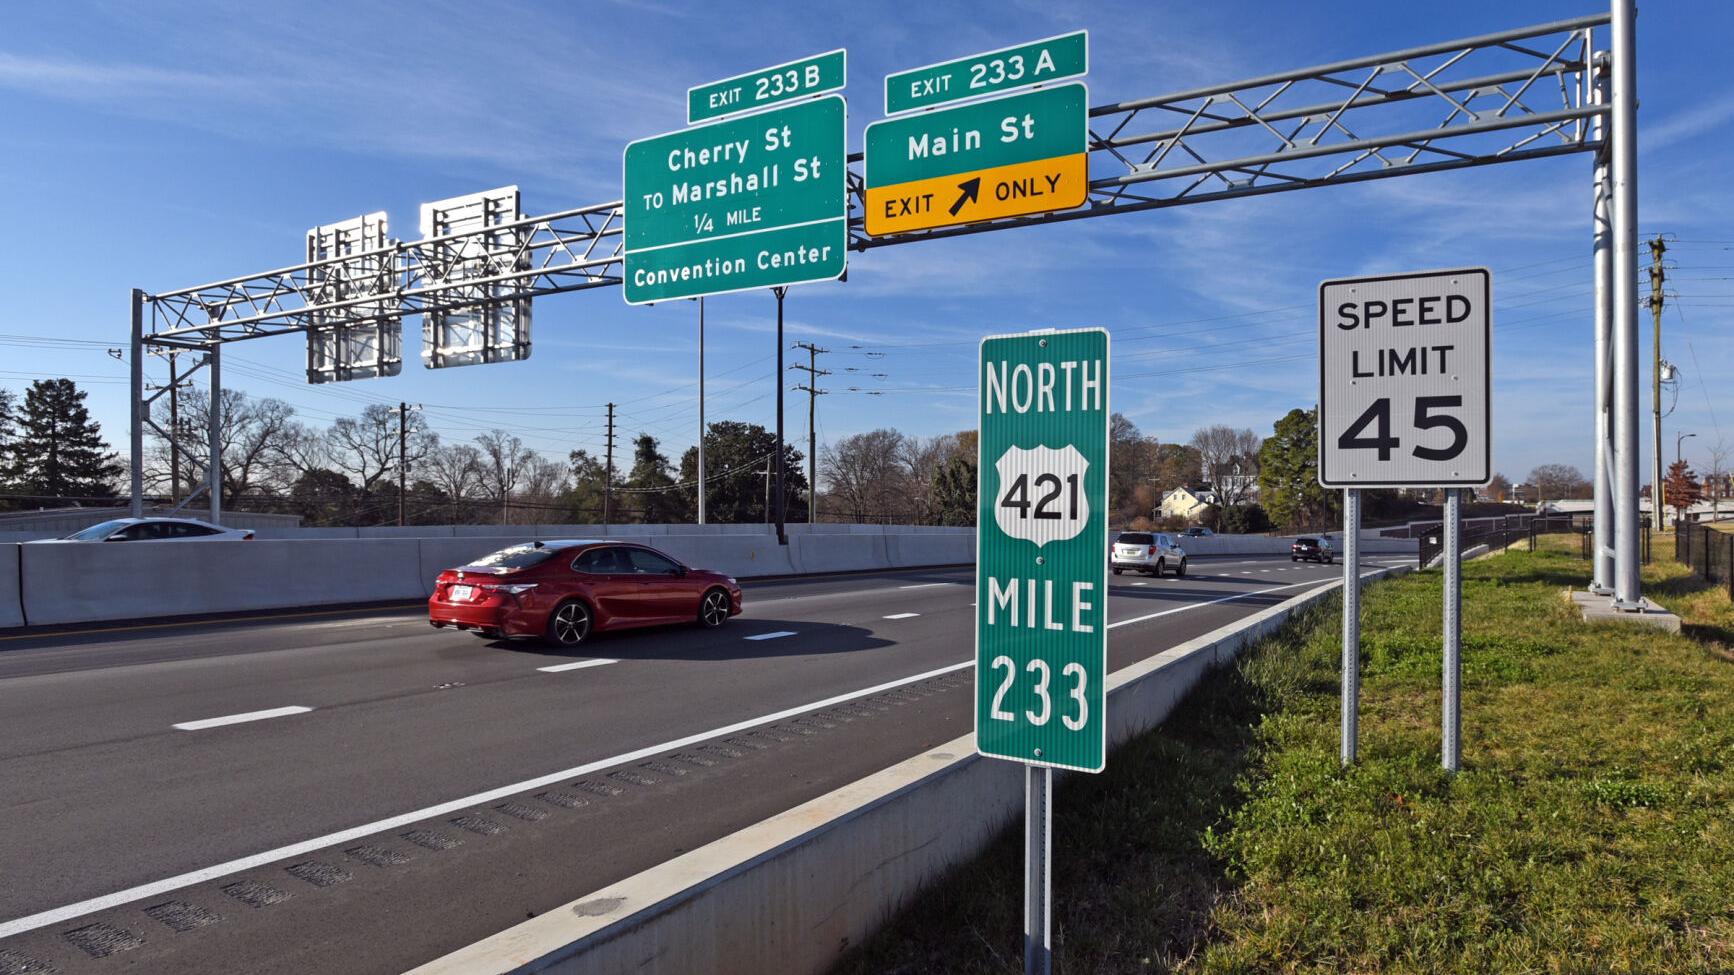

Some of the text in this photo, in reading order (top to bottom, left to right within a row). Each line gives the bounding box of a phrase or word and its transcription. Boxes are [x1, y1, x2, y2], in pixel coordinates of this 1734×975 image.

[709, 87, 742, 108] EXIT
[911, 75, 952, 98] EXIT
[668, 125, 792, 171] Cherry St
[908, 113, 1035, 161] Main St
[643, 156, 821, 210] TO Marshall St
[885, 174, 1062, 219] EXIT ONLY
[727, 207, 762, 226] MILE
[634, 245, 831, 287] Convention Center
[1337, 295, 1472, 331] SPEED
[1352, 345, 1455, 378] LIMIT
[986, 359, 1101, 415] NORTH
[1338, 395, 1468, 462] 45
[1000, 473, 1079, 520] 421
[987, 577, 1094, 633] MILE
[990, 655, 1089, 731] 233
